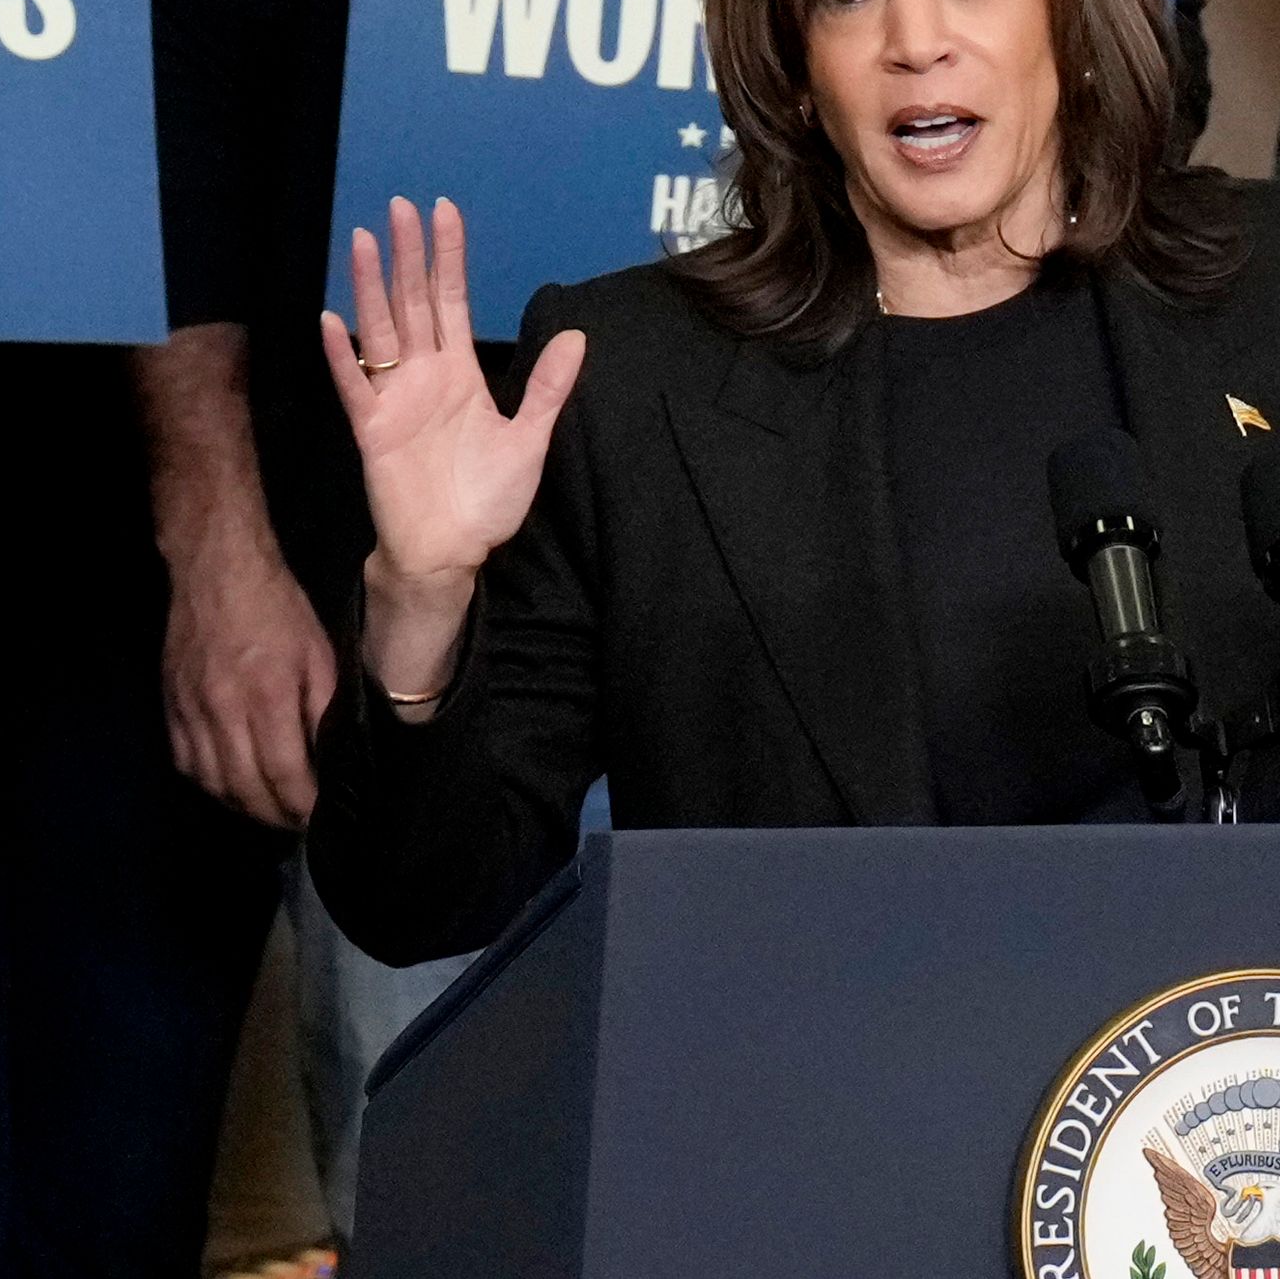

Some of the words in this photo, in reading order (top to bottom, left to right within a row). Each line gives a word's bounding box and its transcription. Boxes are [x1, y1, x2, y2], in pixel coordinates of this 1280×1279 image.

[1034, 1019, 1162, 1279] RESIDENT
[1186, 994, 1241, 1036] OF
[1209, 1164, 1221, 1177] E
